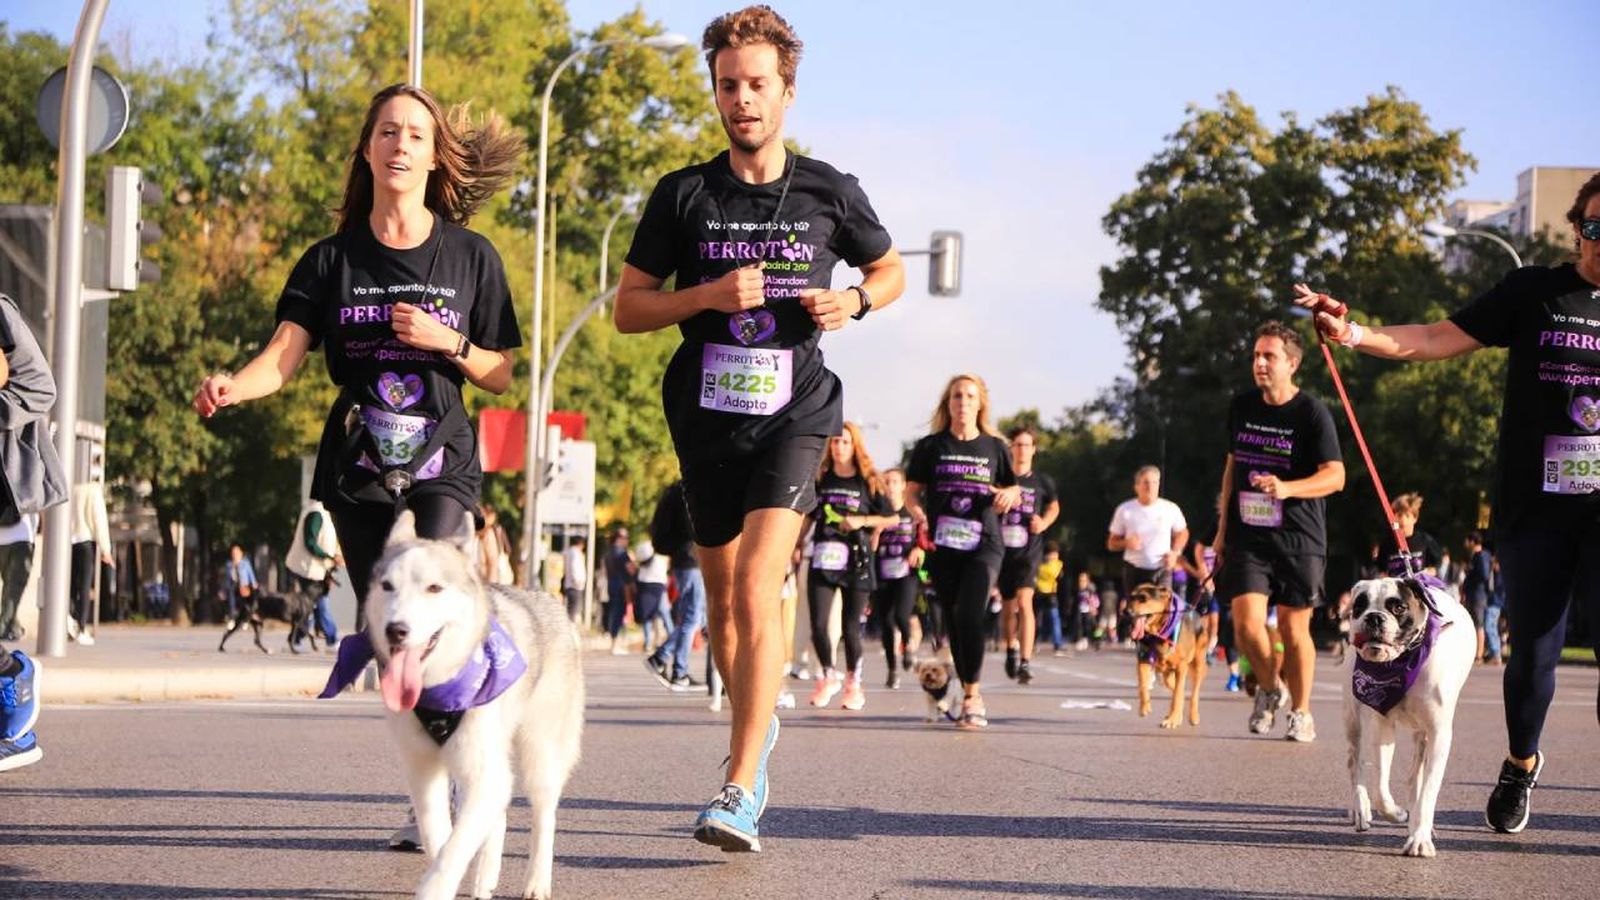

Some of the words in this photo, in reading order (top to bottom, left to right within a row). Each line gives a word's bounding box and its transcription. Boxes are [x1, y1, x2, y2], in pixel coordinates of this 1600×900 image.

[706, 220, 721, 230] Yo
[741, 220, 779, 235] apunto
[764, 260, 791, 272] adrid
[353, 286, 367, 296] Yo
[388, 283, 425, 296] apunto
[1553, 314, 1567, 323] Yo
[1568, 316, 1585, 324] me
[718, 372, 777, 394] 4225
[723, 395, 768, 410] Adopta
